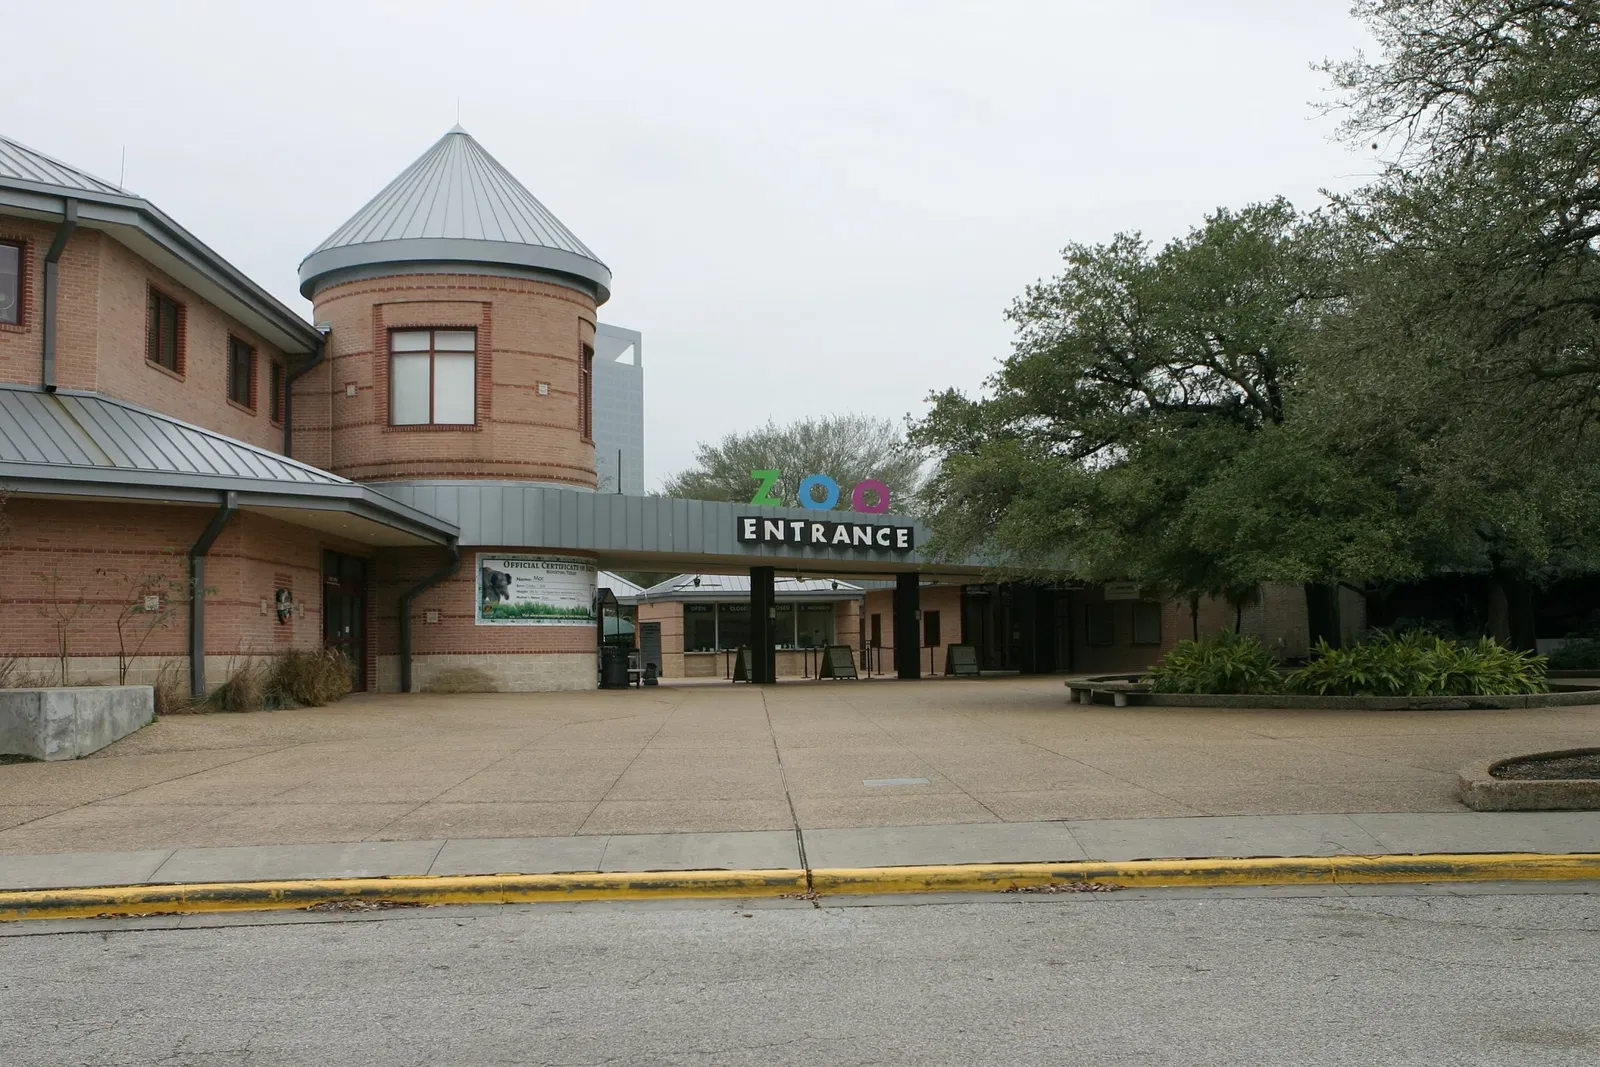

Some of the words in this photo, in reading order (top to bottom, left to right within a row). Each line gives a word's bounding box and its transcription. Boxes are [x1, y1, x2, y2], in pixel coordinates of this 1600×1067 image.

[750, 469, 891, 514] ZOO
[743, 518, 909, 548] ENTRANCE
[541, 561, 579, 571] CERTIFICATE
